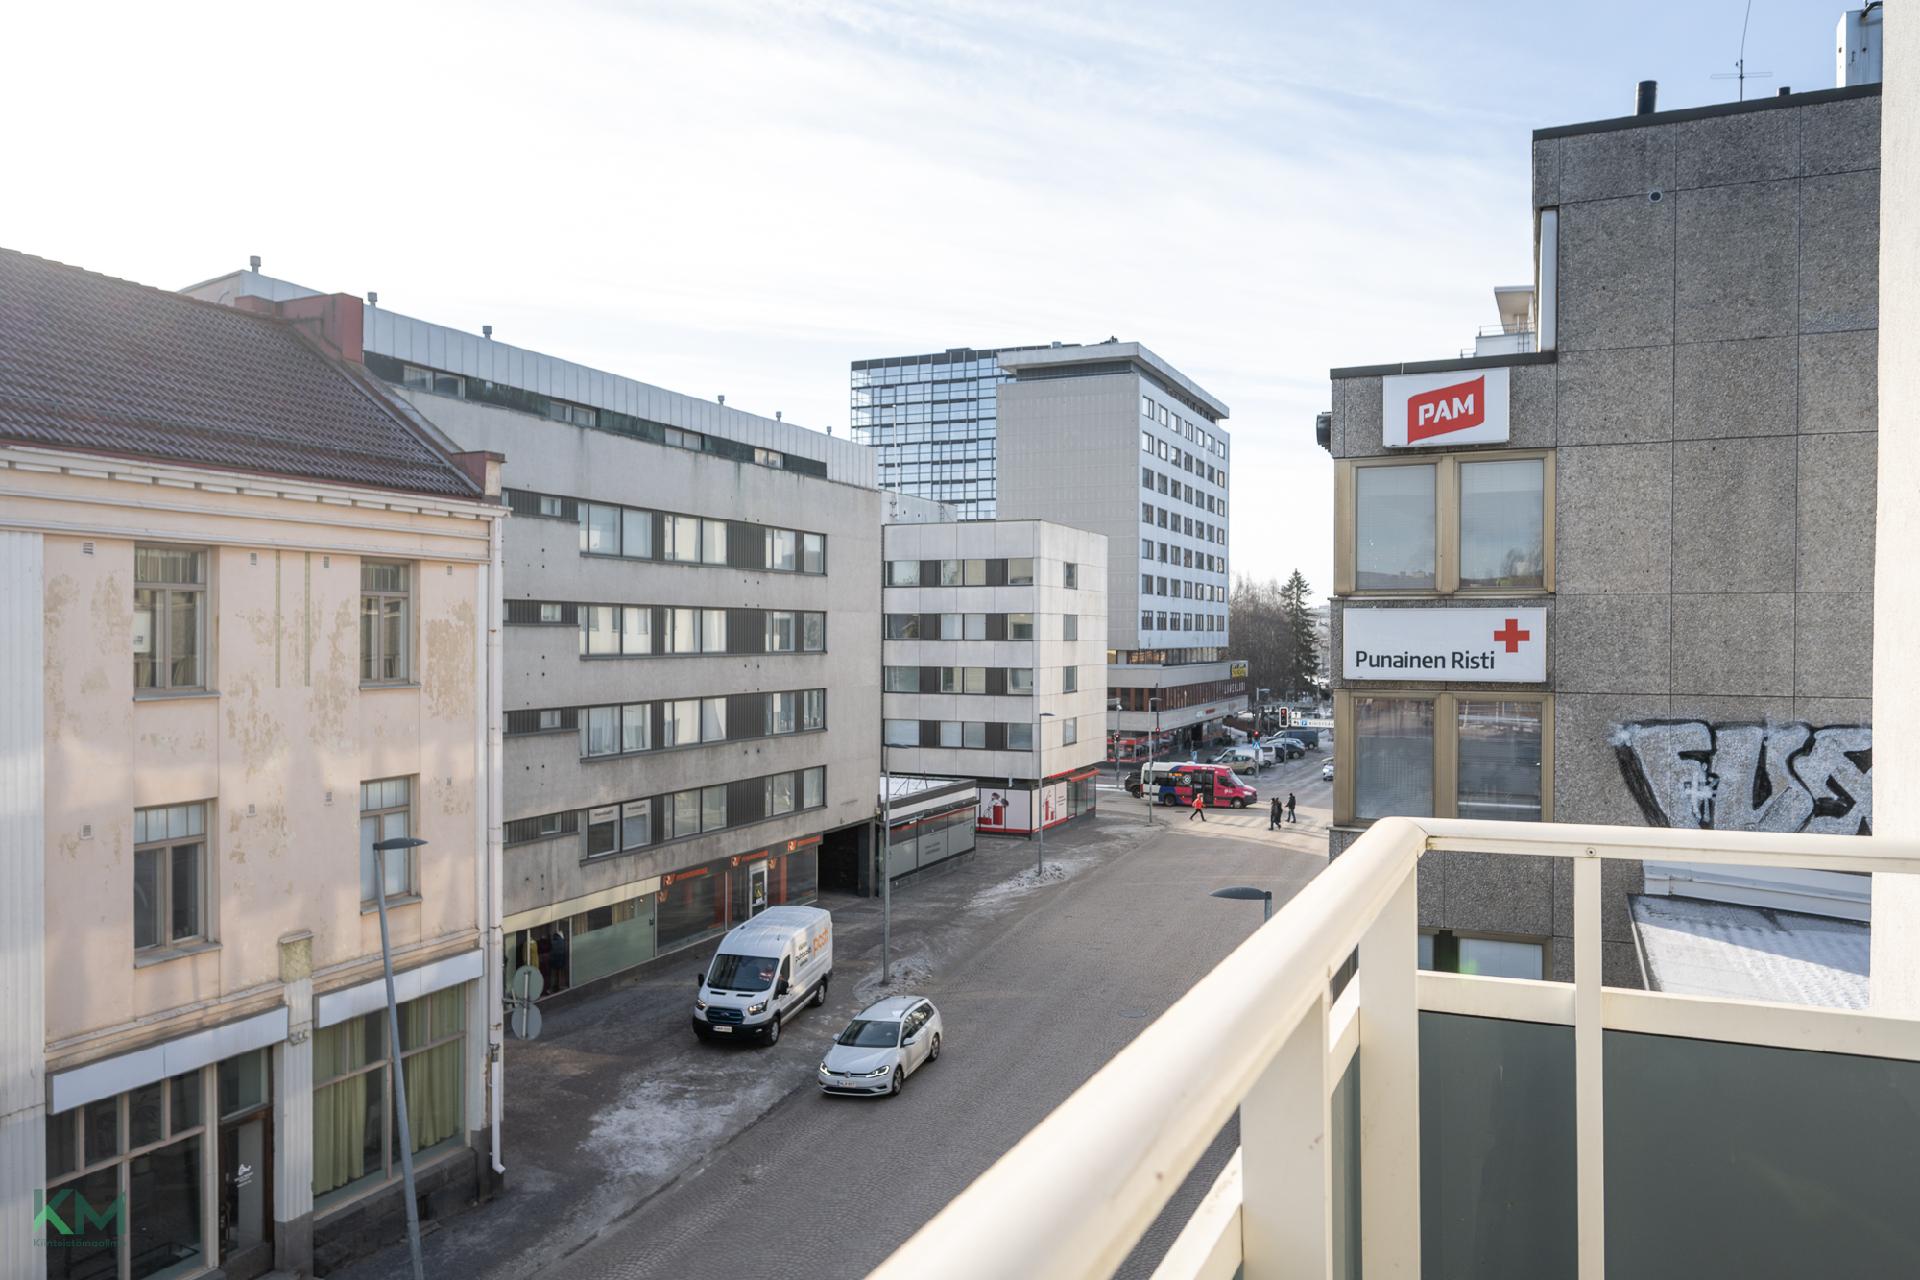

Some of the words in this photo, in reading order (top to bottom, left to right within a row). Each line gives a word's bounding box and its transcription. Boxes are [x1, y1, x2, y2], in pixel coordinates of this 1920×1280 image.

[1418, 393, 1475, 427] PAM
[1355, 650, 1446, 669] Punainen
[1451, 650, 1495, 670] Risti
